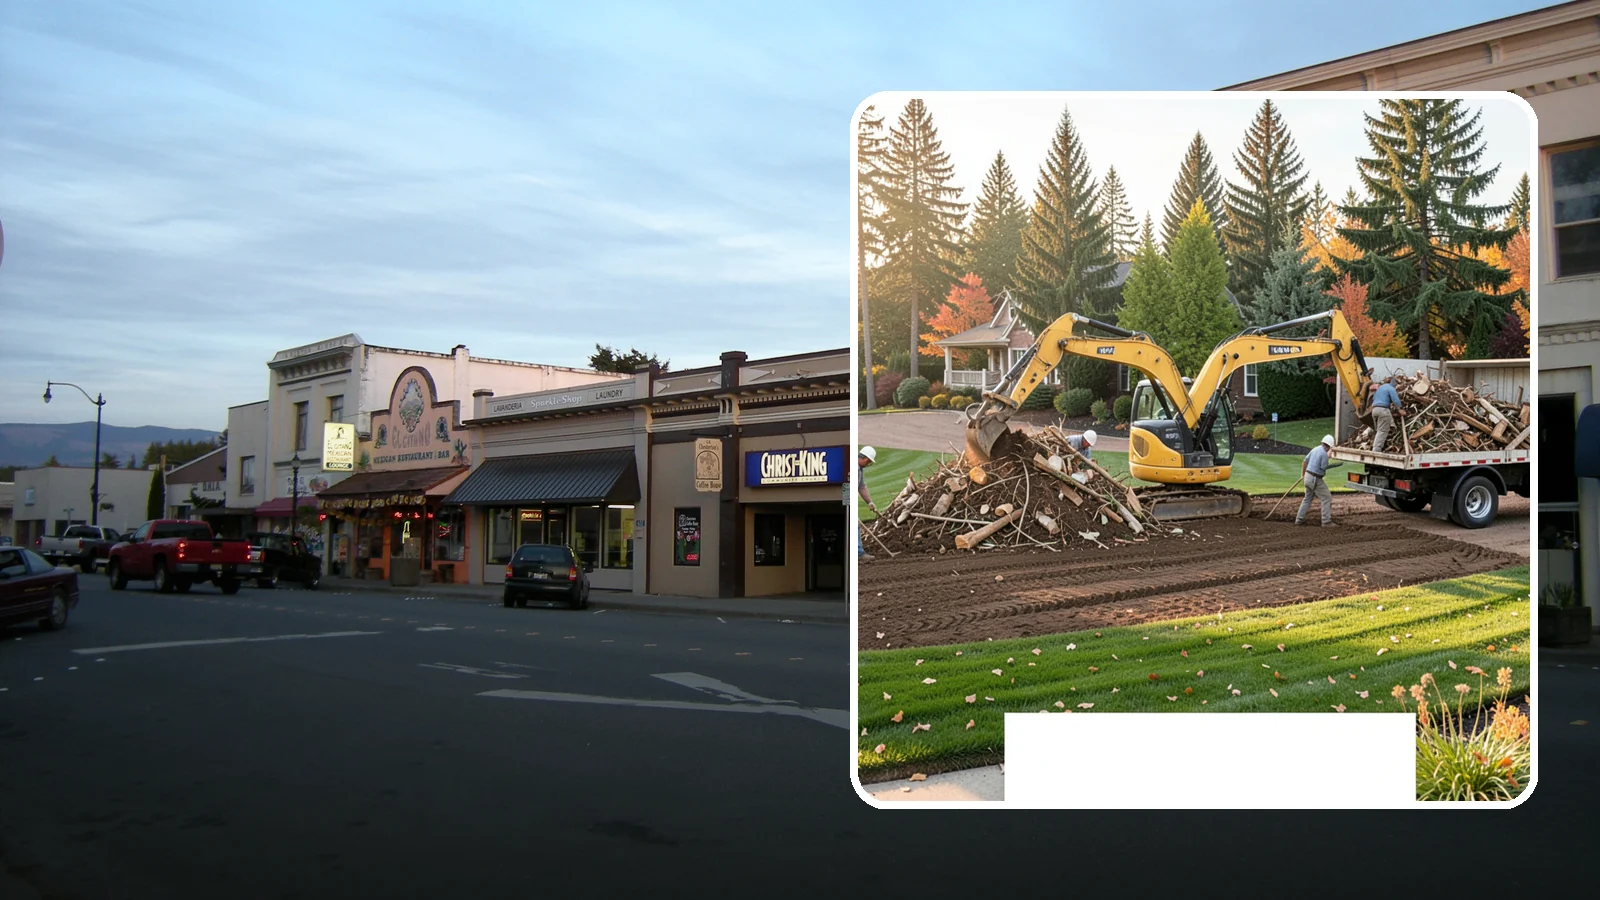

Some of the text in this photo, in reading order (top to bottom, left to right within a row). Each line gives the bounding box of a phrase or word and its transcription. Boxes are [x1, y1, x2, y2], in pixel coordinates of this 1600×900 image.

[494, 389, 624, 412] LAVANDERIA Sparkle Shop LAUNDRY
[373, 455, 396, 464] MEXICAN
[397, 451, 433, 462] RESTAURANT
[438, 450, 450, 458] BAR
[761, 450, 827, 478] CHRIST KING
